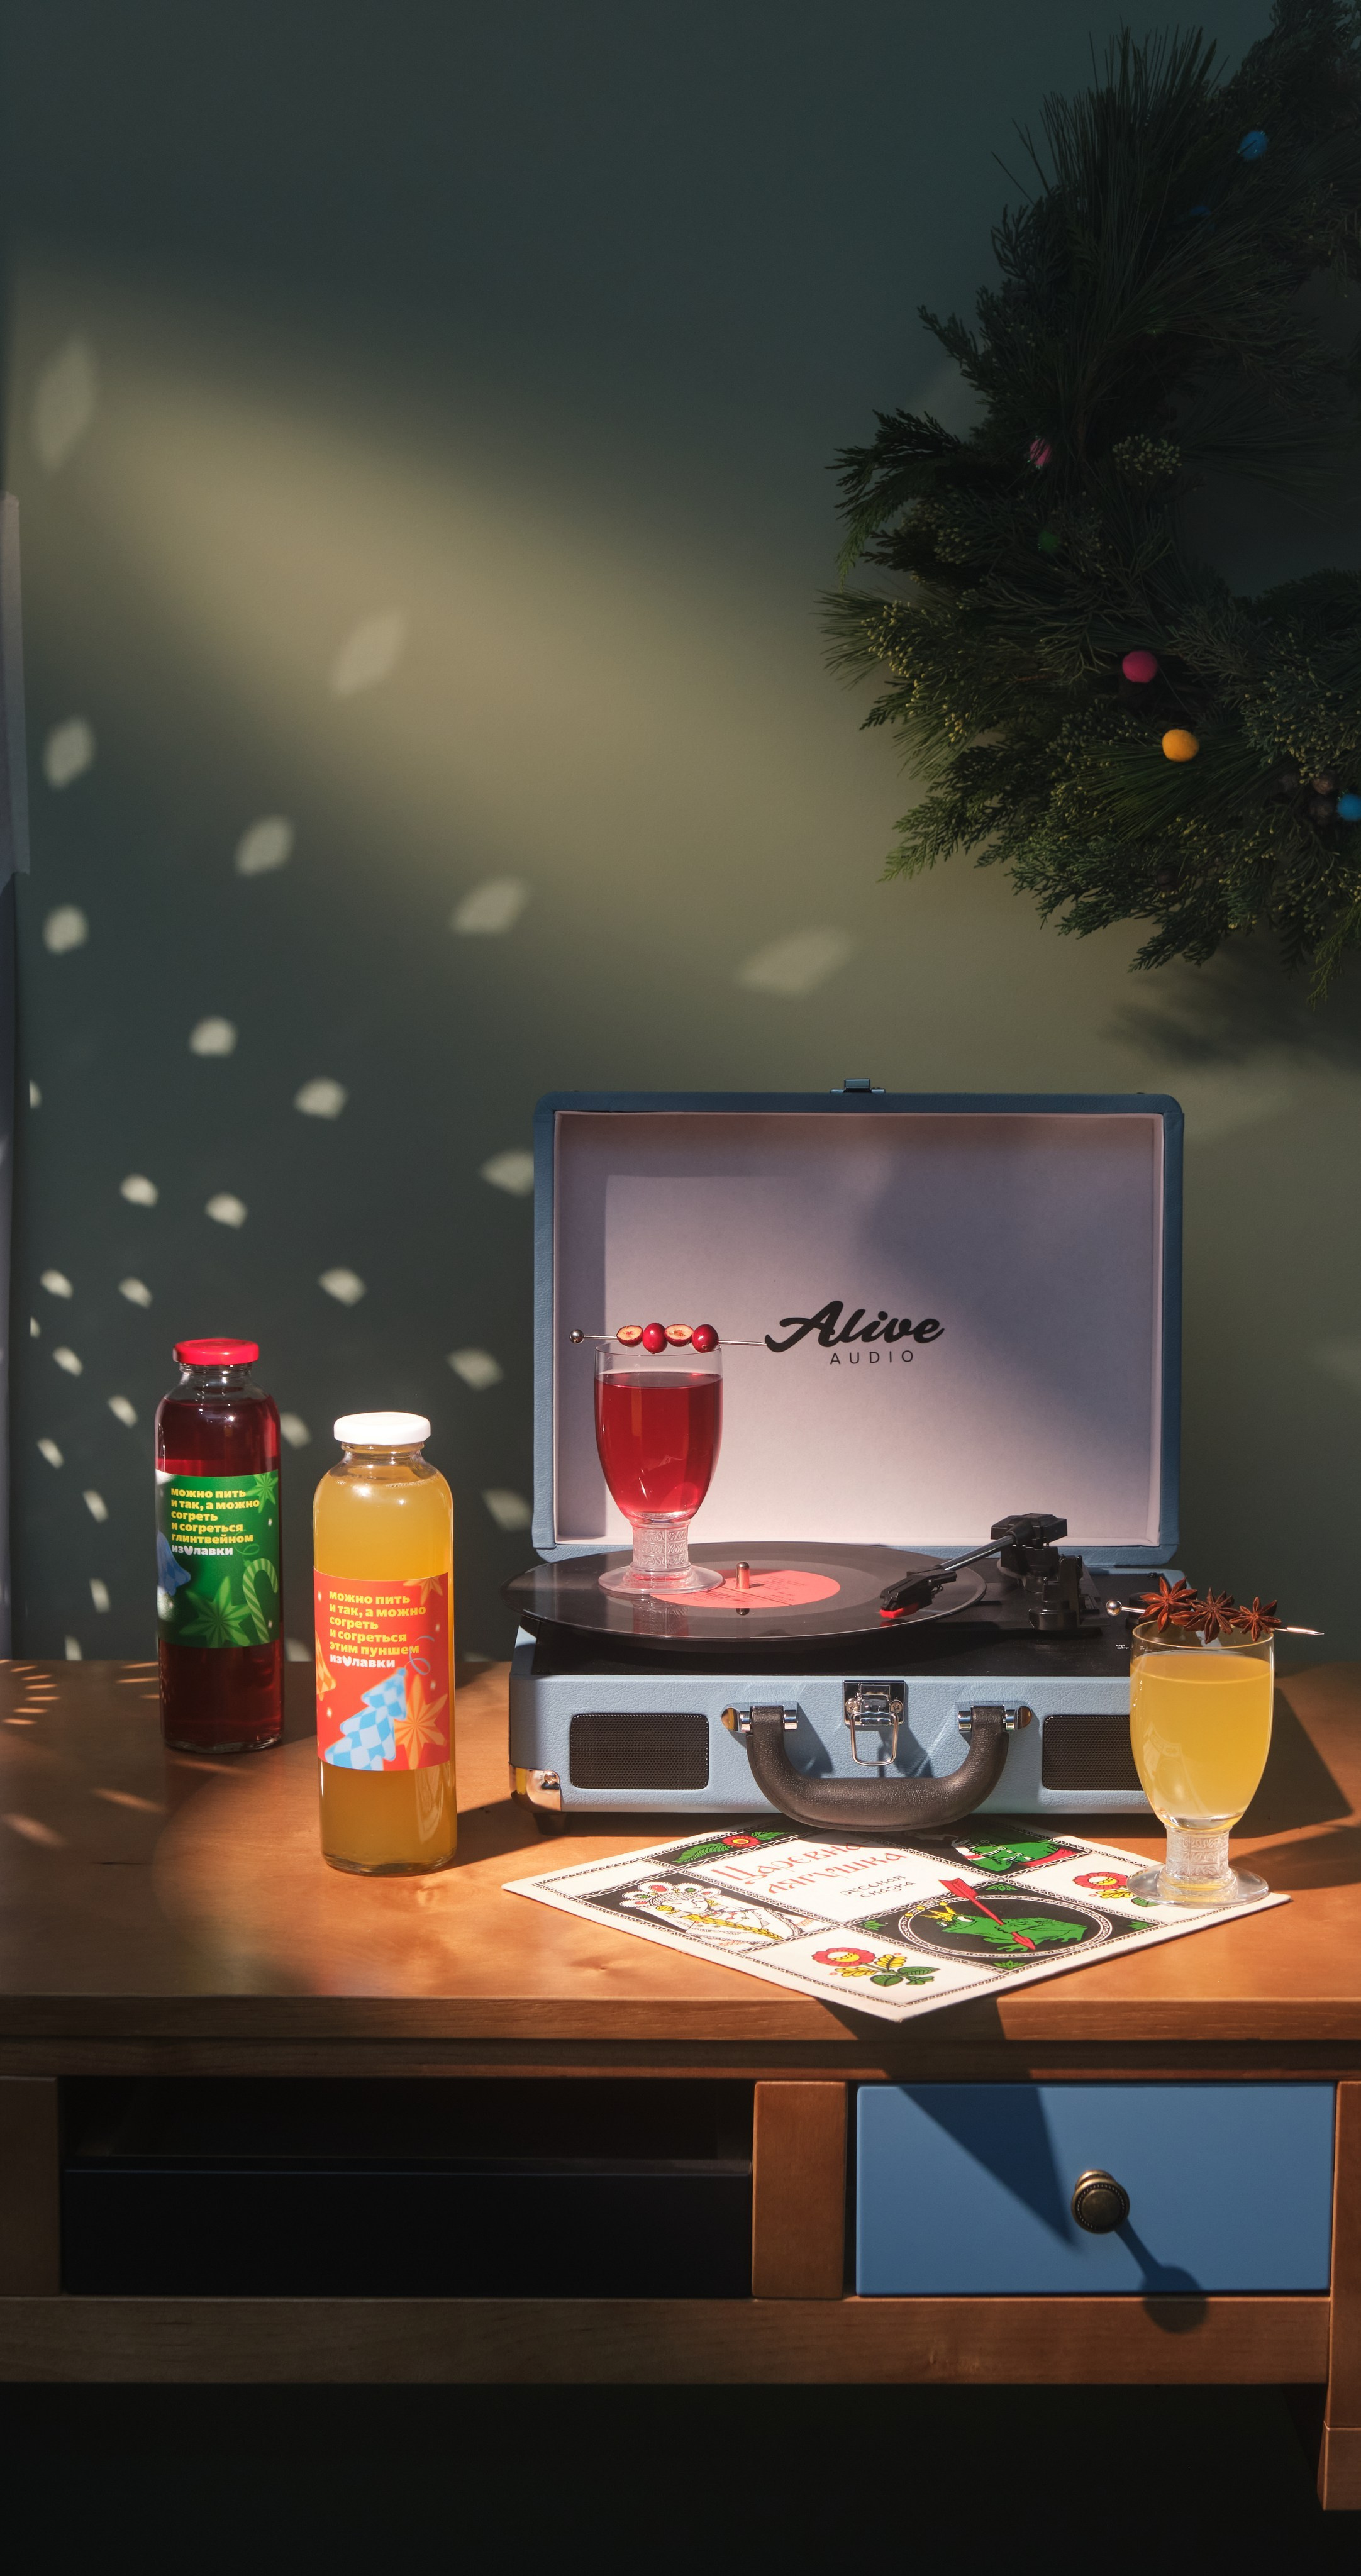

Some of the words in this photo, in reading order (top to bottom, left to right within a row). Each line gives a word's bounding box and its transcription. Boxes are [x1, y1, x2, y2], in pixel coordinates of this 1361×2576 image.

[765, 1301, 945, 1353] Alive
[830, 1350, 914, 1365] AUDIO
[171, 1488, 213, 1498] можно
[179, 1501, 204, 1511] так,
[216, 1500, 260, 1509] можно
[171, 1511, 218, 1522] согреть
[179, 1524, 243, 1534] согреться
[172, 1534, 253, 1544] глинтвейном
[329, 1591, 373, 1604] можно
[375, 1596, 410, 1604] пить
[329, 1604, 336, 1612] и
[338, 1606, 363, 1618] так,
[365, 1609, 374, 1617] а
[376, 1606, 426, 1618] можно
[329, 1616, 379, 1630] согреть
[330, 1629, 336, 1637] и
[338, 1631, 407, 1644] согреться
[330, 1641, 358, 1654] этим
[360, 1645, 419, 1658] пуншем
[860, 1882, 916, 1898] сказка
